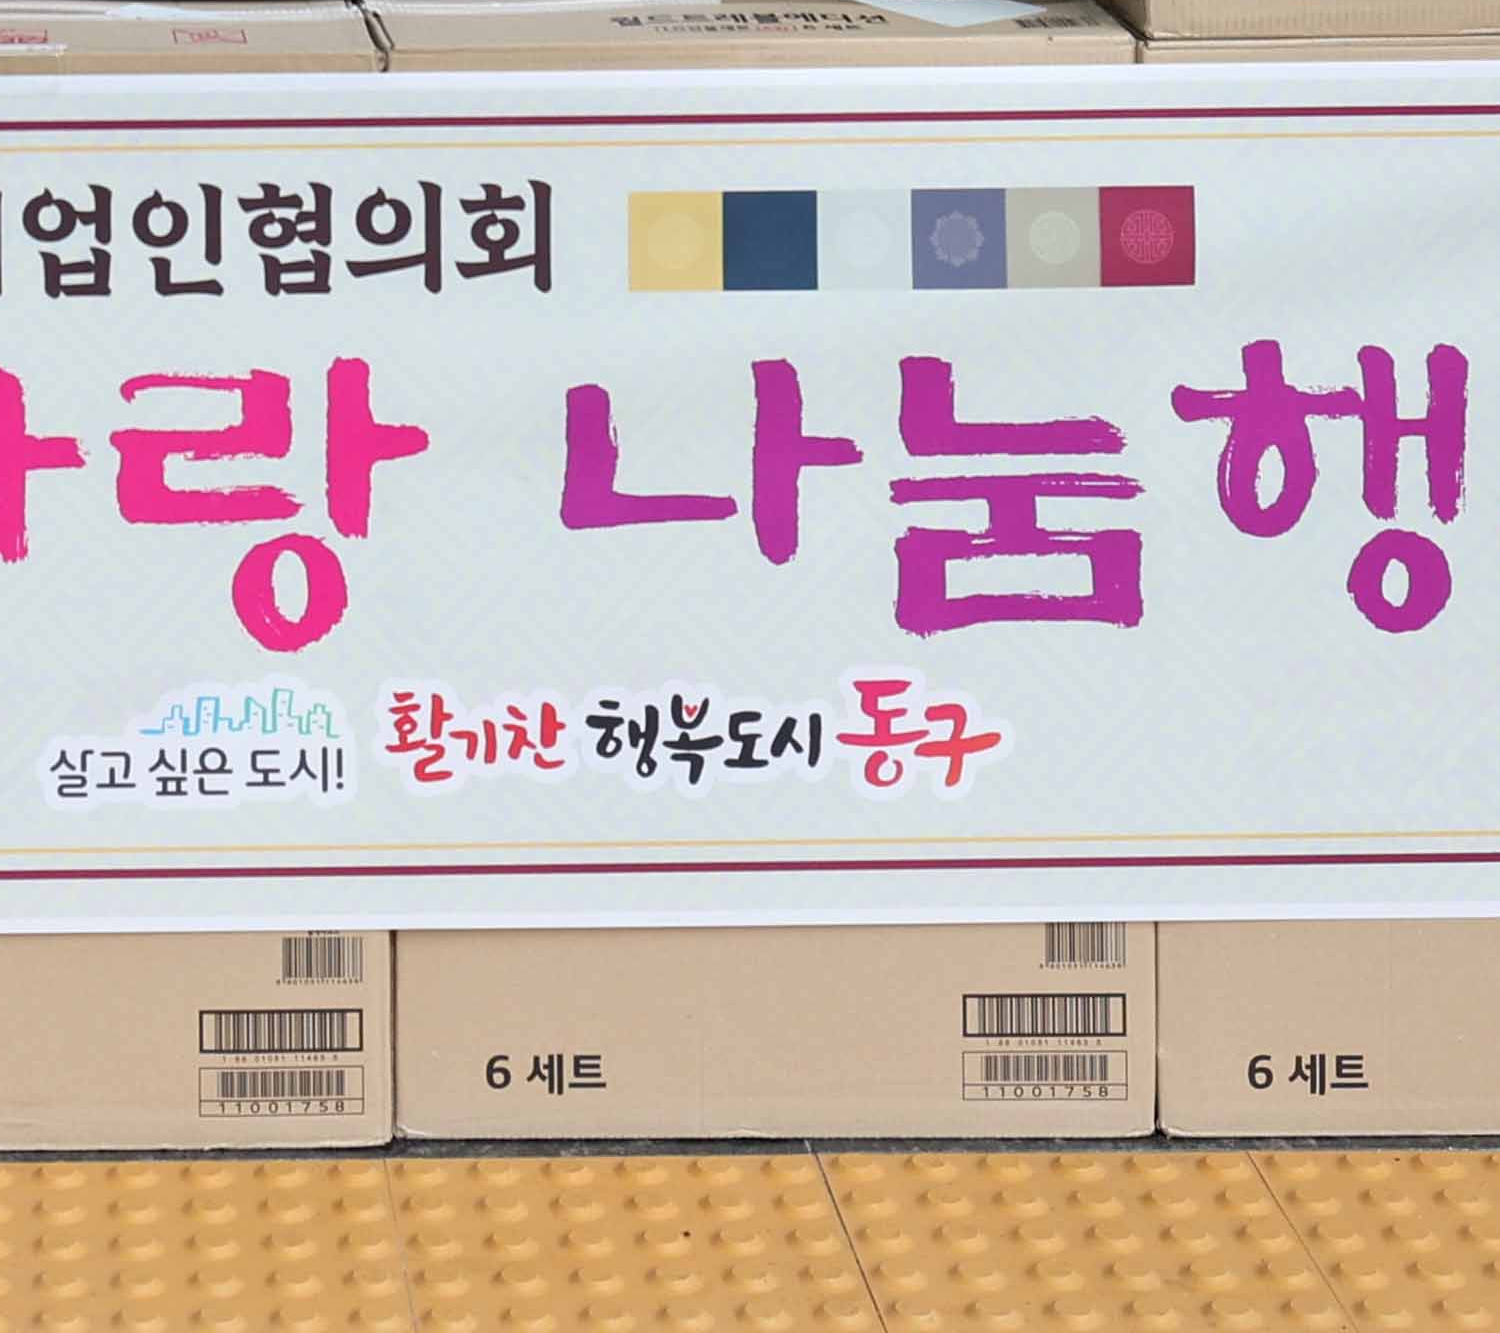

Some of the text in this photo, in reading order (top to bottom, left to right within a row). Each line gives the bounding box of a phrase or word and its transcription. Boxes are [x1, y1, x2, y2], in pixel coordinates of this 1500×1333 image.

[49, 678, 1000, 796] 살고 싶은 도시! 활기찬 행복도시 동구
[1248, 1053, 1368, 1095] 6 세트
